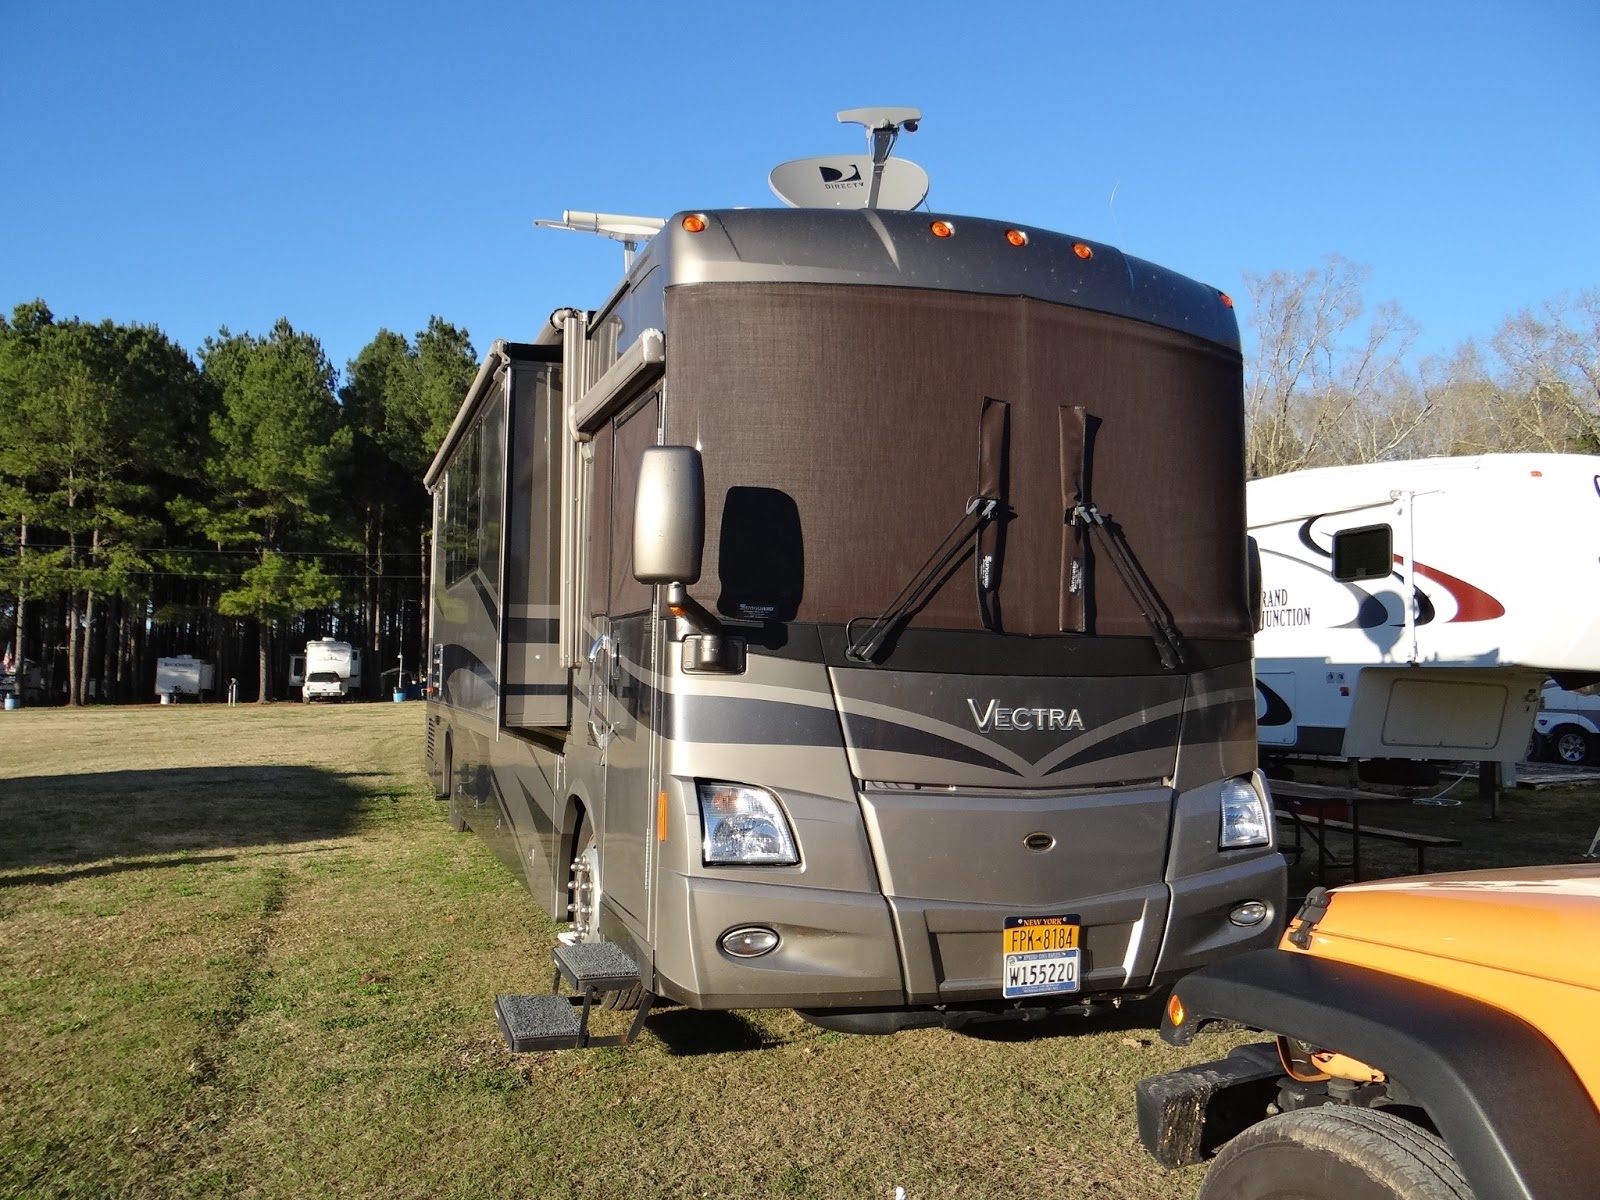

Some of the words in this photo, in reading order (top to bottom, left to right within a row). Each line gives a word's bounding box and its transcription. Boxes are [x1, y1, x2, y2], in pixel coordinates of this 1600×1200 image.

[824, 181, 864, 190] DIRECTV
[1263, 588, 1288, 607] RAND
[1260, 607, 1311, 631] JUNCTION
[967, 699, 1085, 733] VECTRA
[1043, 917, 1062, 925] YORK
[1009, 962, 1075, 986] W155220
